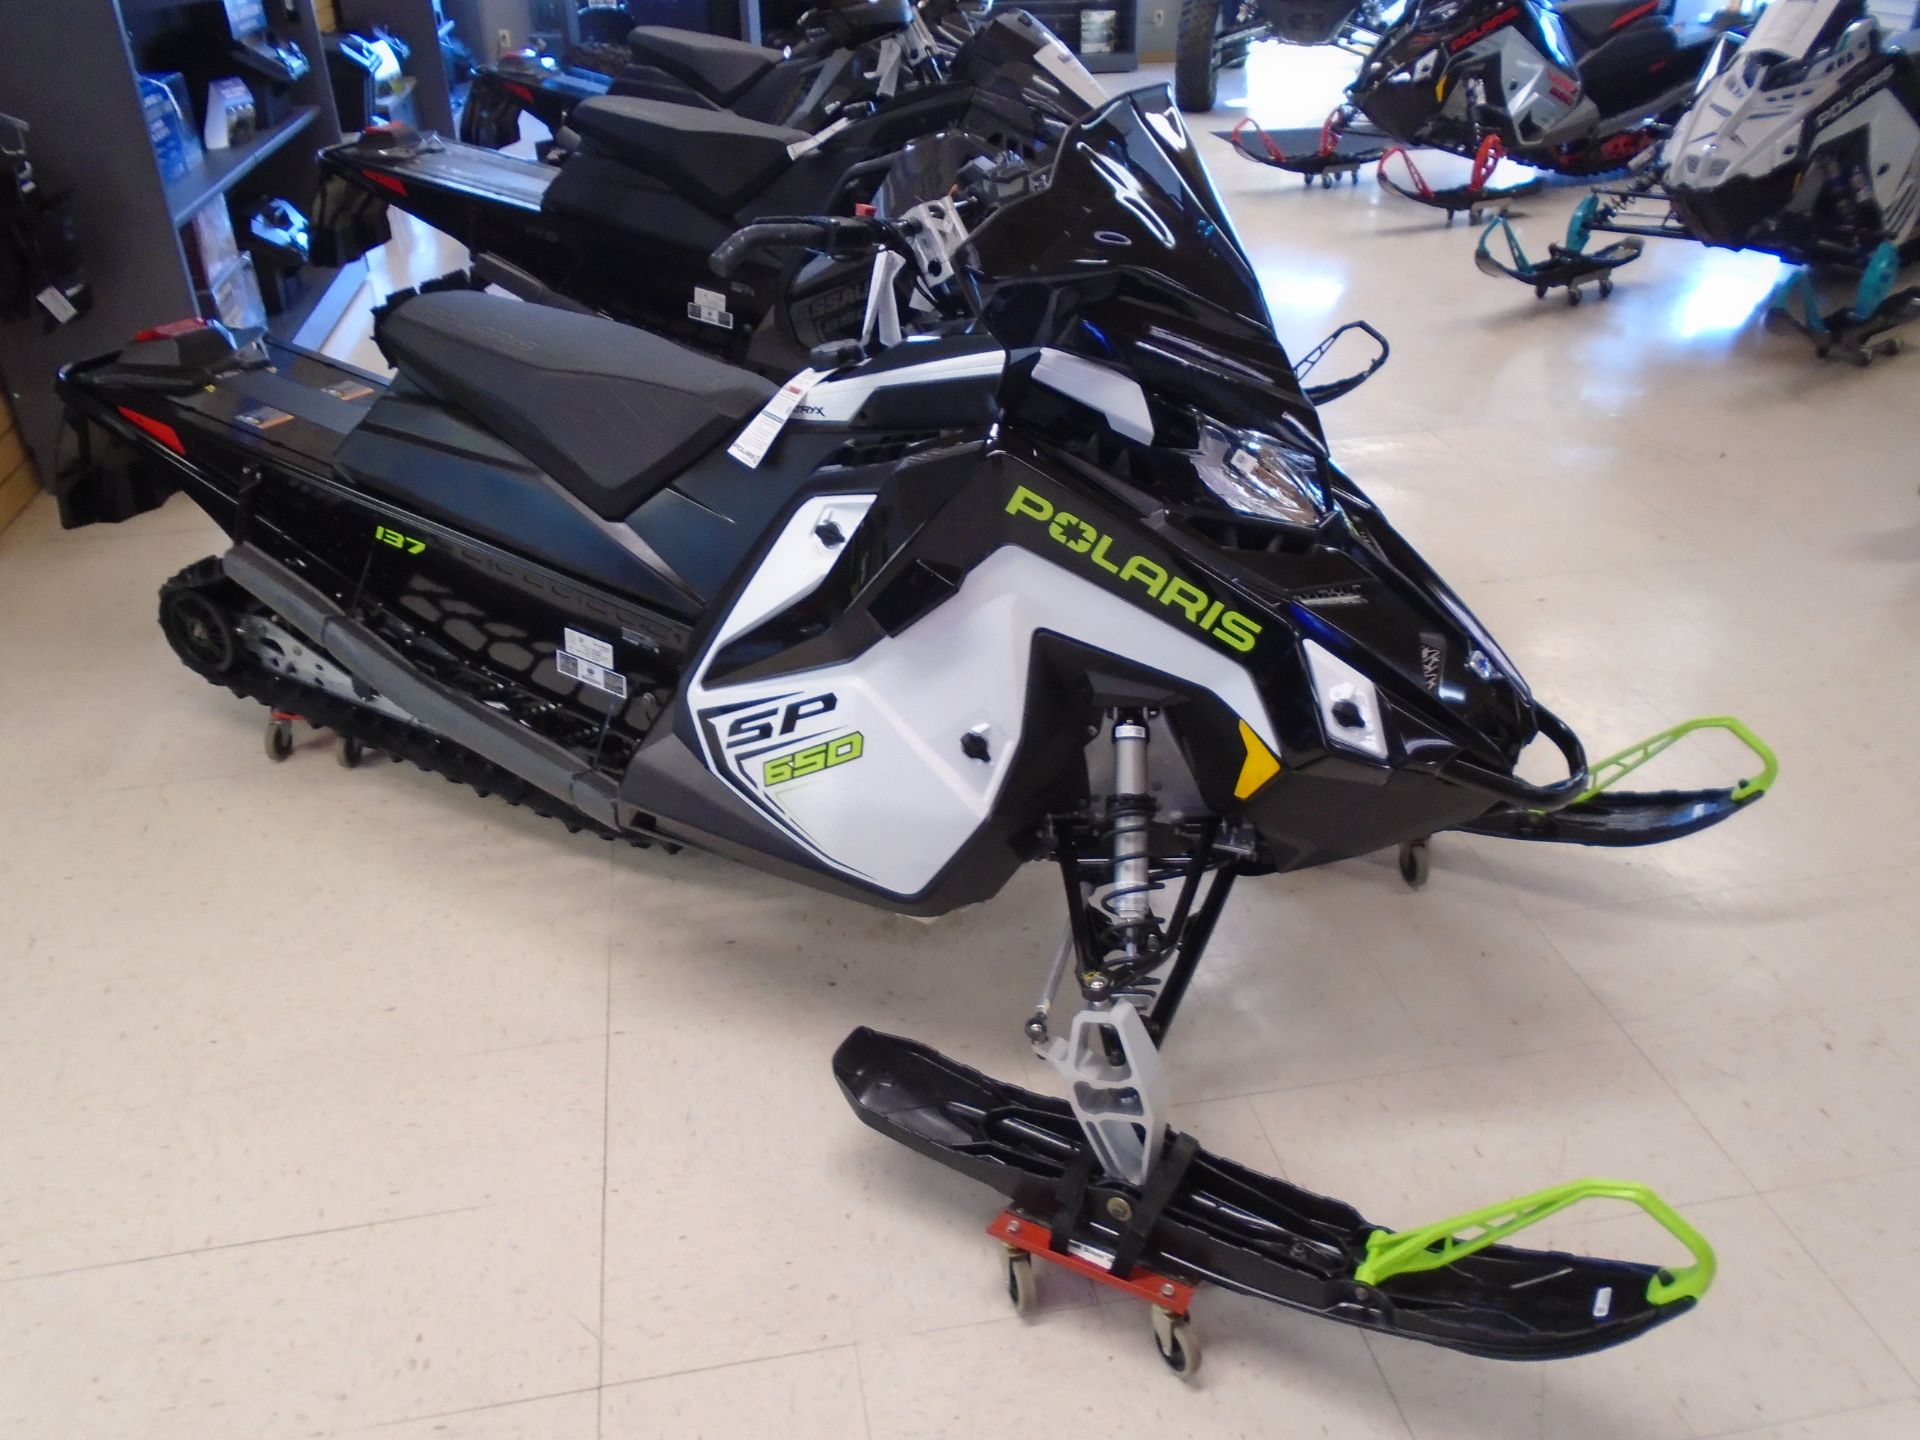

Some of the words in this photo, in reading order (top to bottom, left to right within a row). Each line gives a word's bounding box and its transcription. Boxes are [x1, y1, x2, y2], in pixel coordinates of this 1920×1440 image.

[375, 525, 426, 554] 137
[1005, 485, 1263, 652] POLARIS
[725, 692, 837, 749] SP
[763, 731, 864, 787] 650
